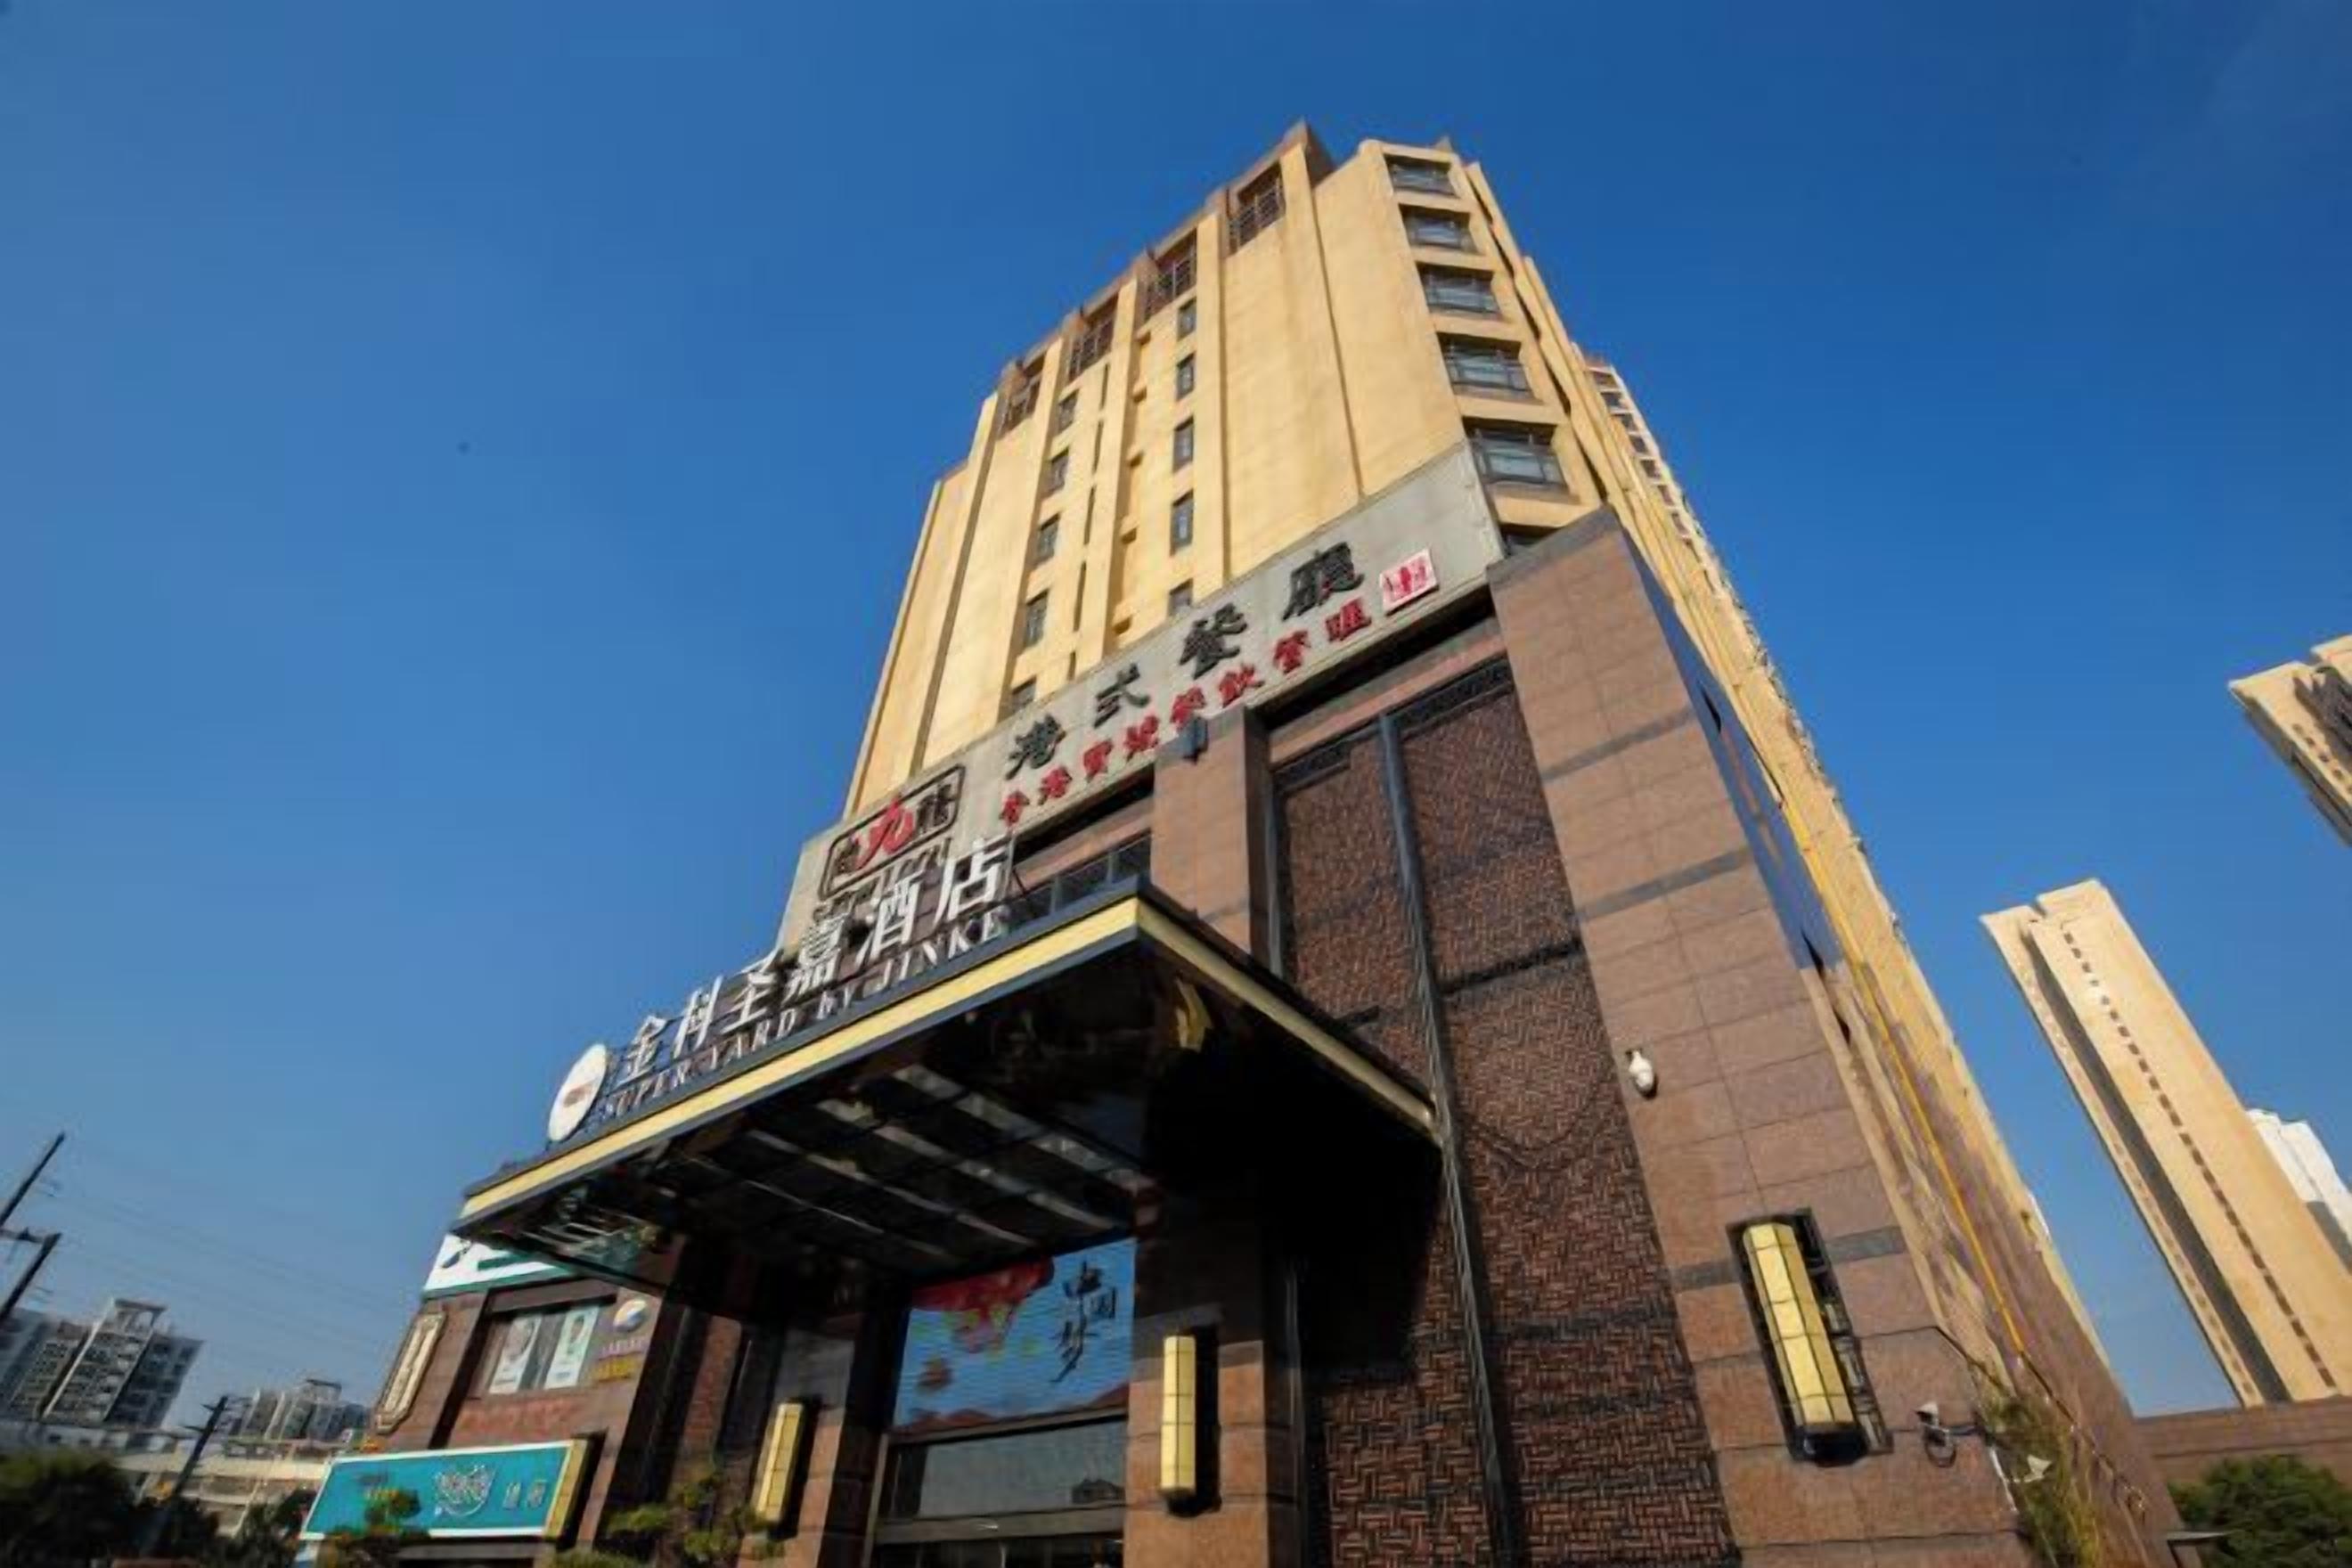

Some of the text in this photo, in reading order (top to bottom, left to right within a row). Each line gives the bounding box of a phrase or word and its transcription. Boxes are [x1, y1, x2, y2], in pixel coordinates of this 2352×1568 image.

[619, 837, 1008, 1085] 金科圣嘉酒店
[706, 1008, 796, 1070] YARD
[866, 904, 1012, 997] JINKE
